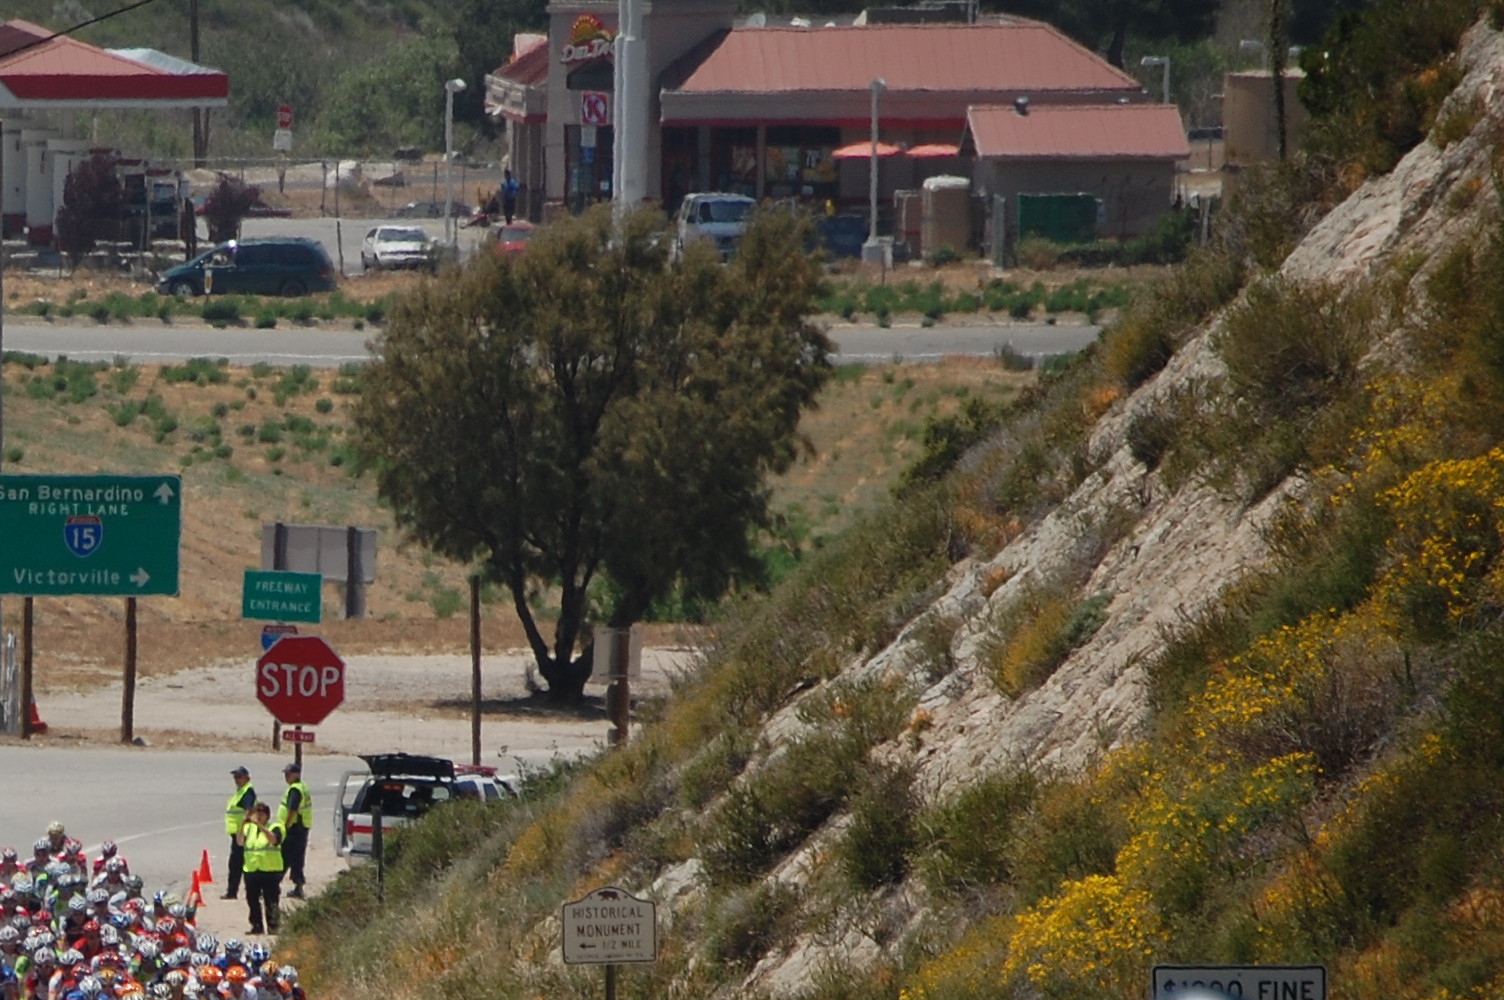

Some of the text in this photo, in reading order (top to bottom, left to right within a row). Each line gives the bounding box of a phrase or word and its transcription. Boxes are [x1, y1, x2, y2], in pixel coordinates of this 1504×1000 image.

[38, 484, 144, 502] Bernardino
[28, 502, 129, 516] RIGHT LANE
[73, 527, 96, 551] 15
[14, 568, 121, 586] Victorville
[255, 581, 309, 594] FREEWAY
[250, 599, 313, 613] ENTRANCE
[261, 662, 340, 697] STOP
[572, 907, 644, 919] HISTORICAL
[576, 923, 641, 938] MONUMENT
[602, 940, 642, 950] 1/2 MILE
